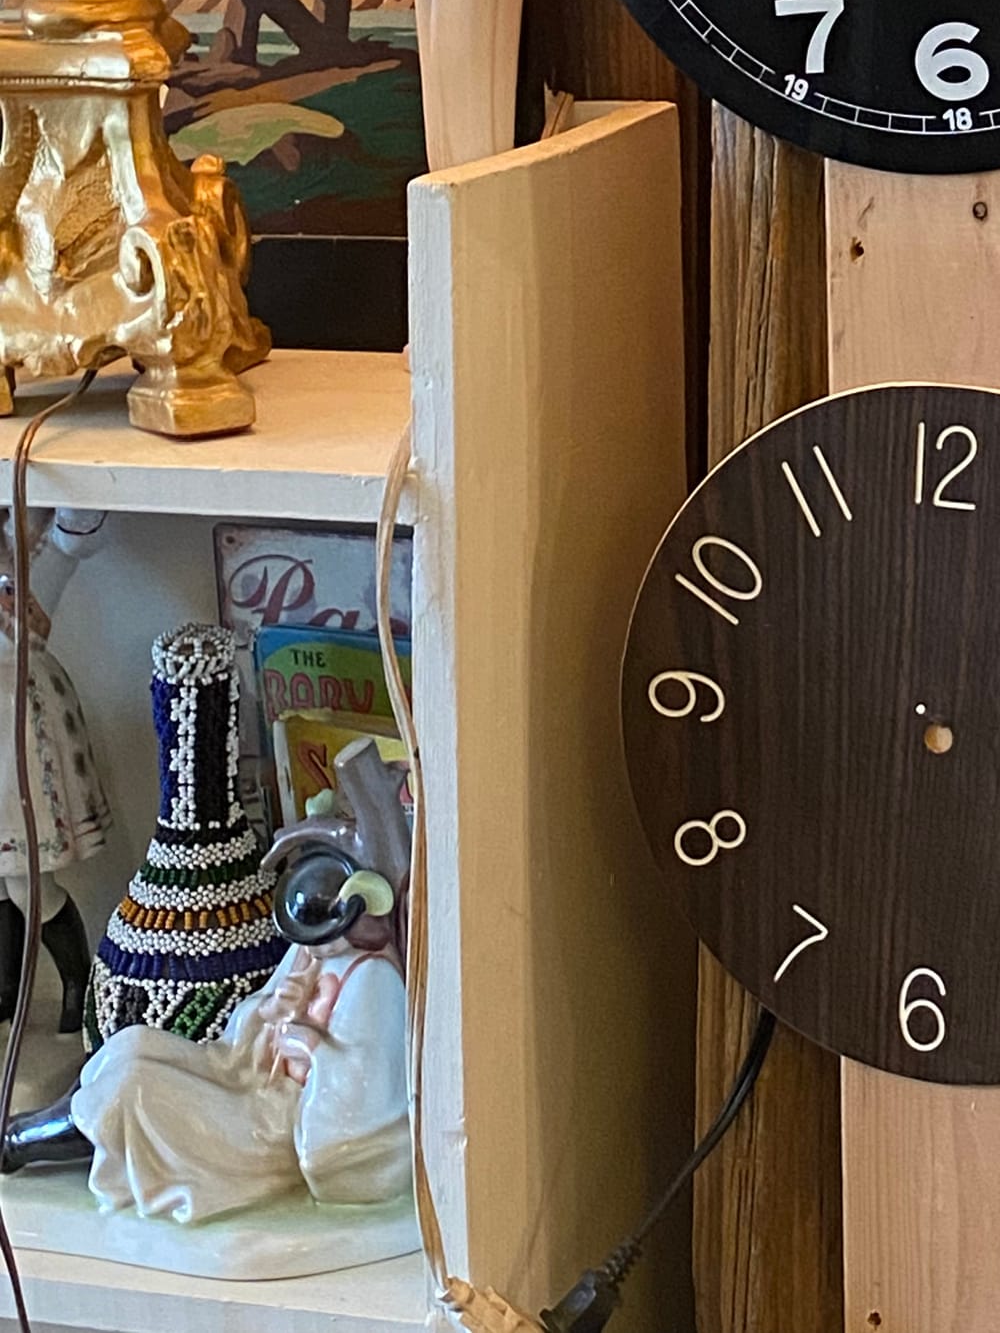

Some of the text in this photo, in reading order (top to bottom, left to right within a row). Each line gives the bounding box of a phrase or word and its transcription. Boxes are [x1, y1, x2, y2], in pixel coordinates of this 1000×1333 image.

[783, 74, 809, 103] 19
[915, 22, 989, 101] 6
[944, 108, 973, 132] 18
[782, 446, 852, 536] 11
[915, 422, 977, 510] 12
[676, 537, 762, 625] 10
[290, 648, 326, 668] THE
[649, 672, 724, 722] 9
[675, 811, 746, 865] 8
[774, 905, 828, 981] 7
[900, 968, 946, 1051] 6
